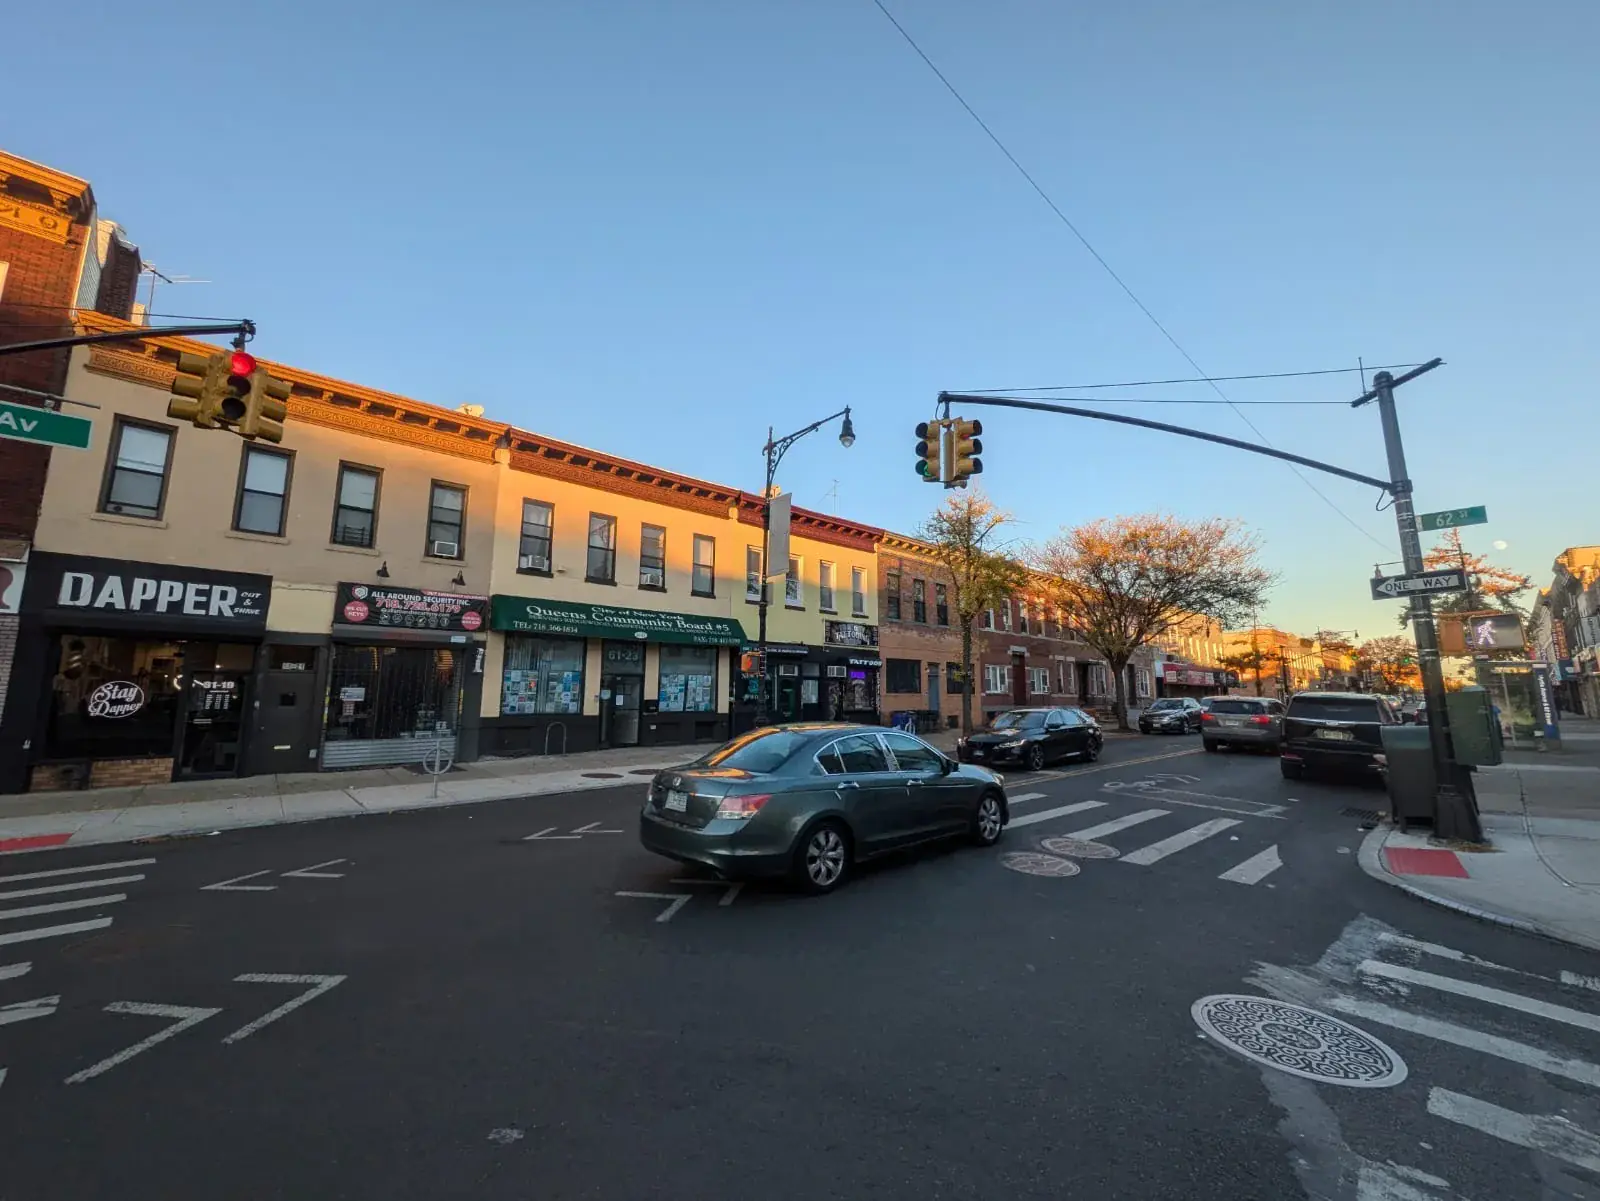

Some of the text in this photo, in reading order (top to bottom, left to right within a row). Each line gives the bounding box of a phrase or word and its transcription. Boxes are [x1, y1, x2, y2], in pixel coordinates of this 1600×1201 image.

[0, 411, 39, 433] Av
[1436, 512, 1454, 527] 62
[1384, 576, 1452, 592] ONE WAY
[57, 571, 238, 617] DAPPER
[243, 598, 253, 606] &
[371, 591, 385, 599] ALL
[387, 592, 421, 602] AROUND
[423, 595, 456, 605] SECURITY
[233, 607, 260, 615] SHAVE
[526, 605, 729, 632] Queens Community Board #5
[591, 606, 616, 615] City
[95, 682, 139, 701] Stay
[88, 700, 143, 717] Dapper
